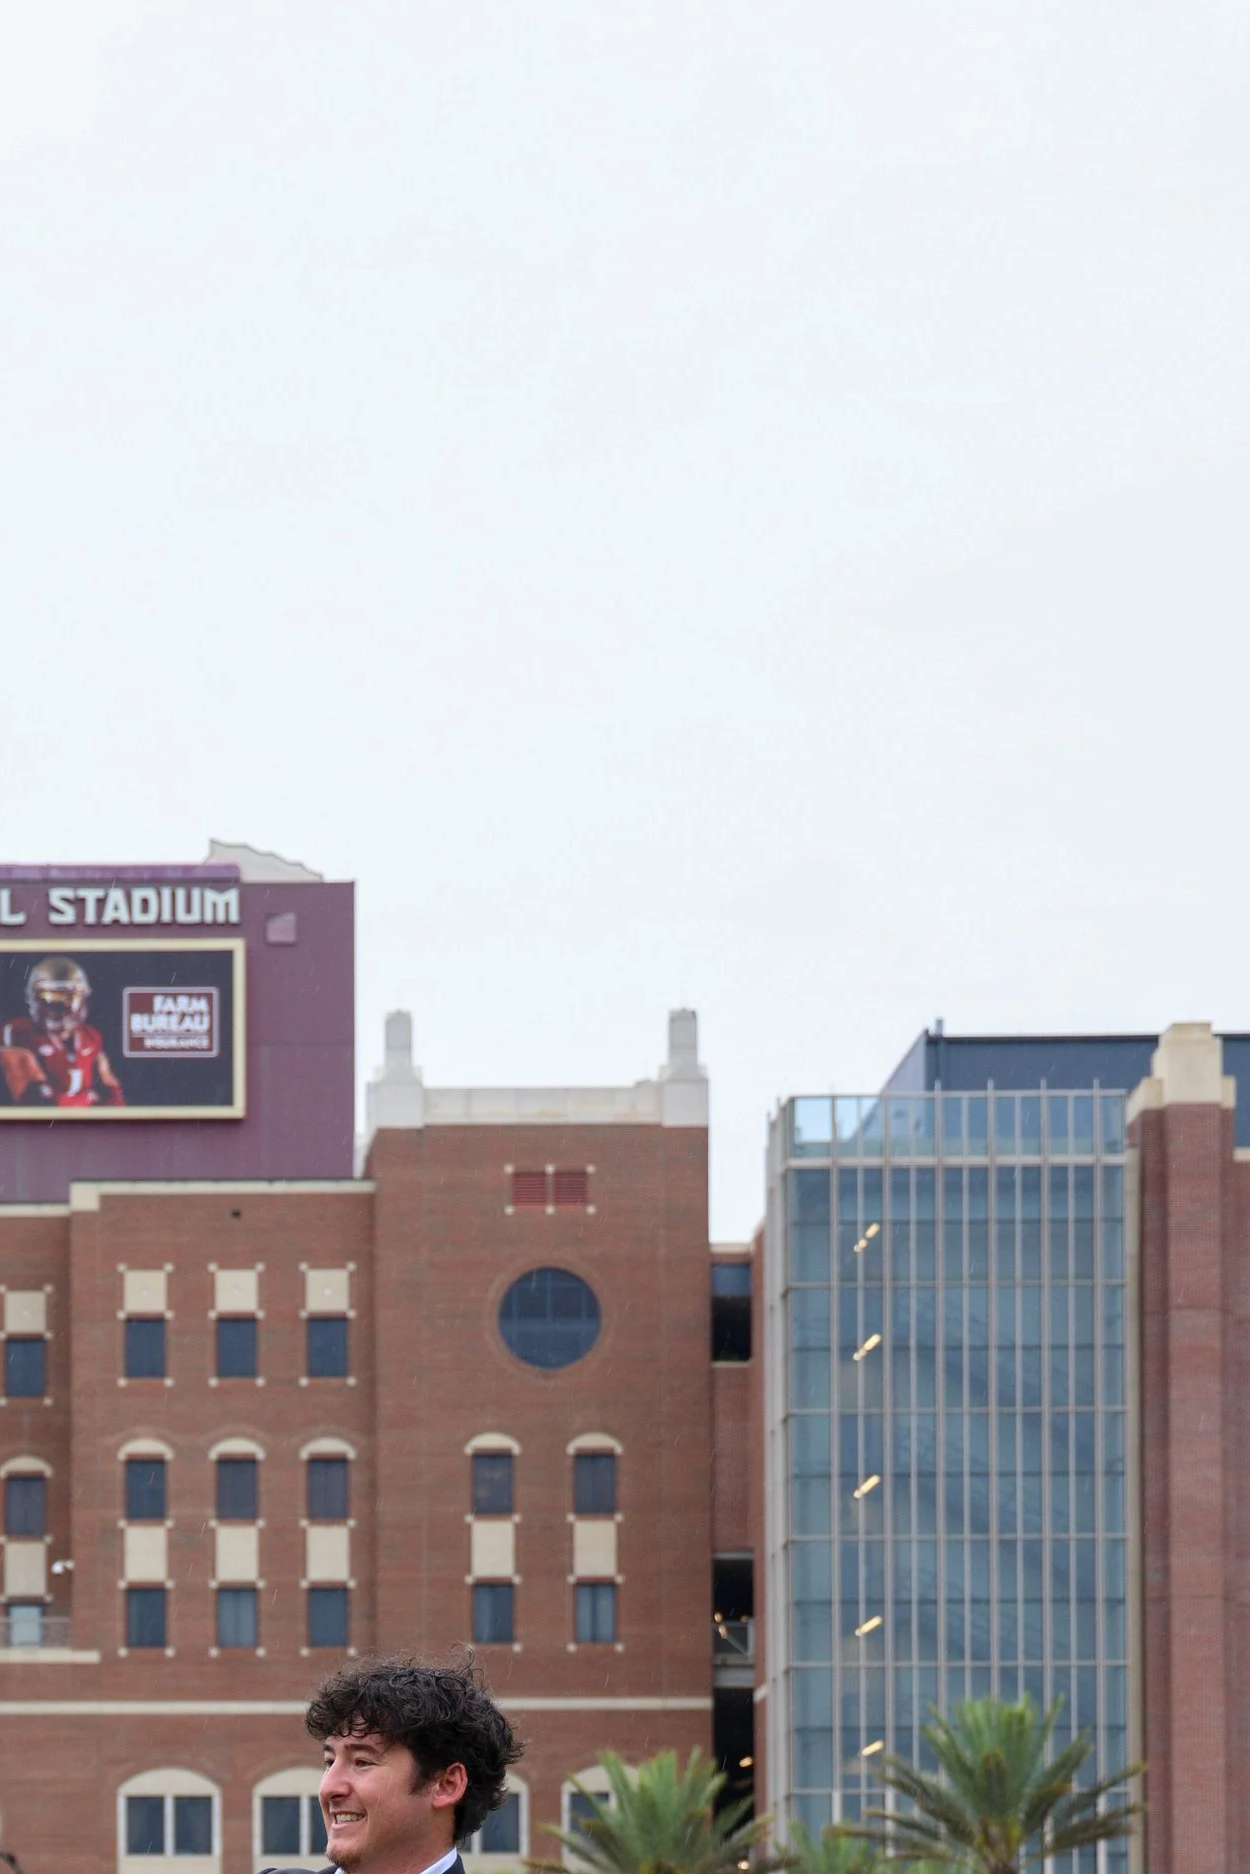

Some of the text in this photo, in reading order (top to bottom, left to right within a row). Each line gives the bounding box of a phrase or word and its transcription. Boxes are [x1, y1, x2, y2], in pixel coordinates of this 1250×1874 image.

[48, 886, 240, 925] STADIUM
[153, 994, 209, 1012] FARM
[131, 1013, 210, 1033] BUREAU
